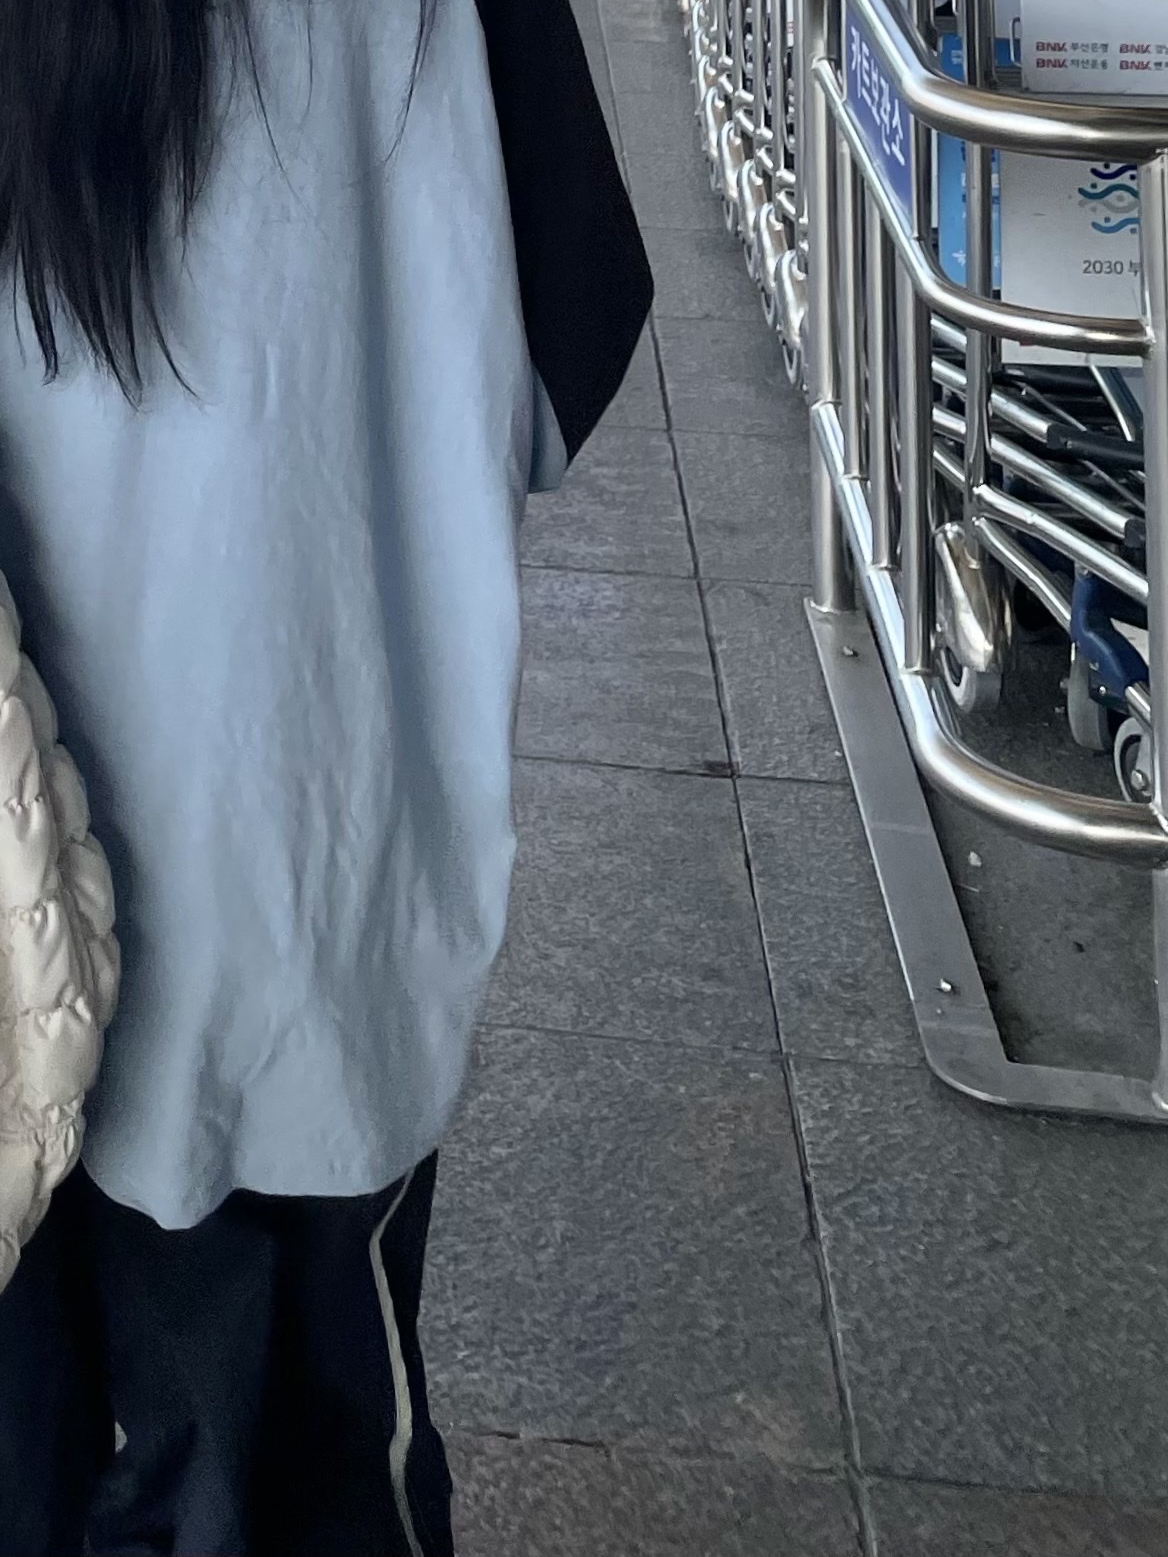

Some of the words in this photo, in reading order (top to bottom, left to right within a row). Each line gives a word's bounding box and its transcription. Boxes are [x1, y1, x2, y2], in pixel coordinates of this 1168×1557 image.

[1035, 41, 1067, 52] BNK
[1119, 43, 1151, 54] BNK
[1035, 58, 1068, 69] BNK
[1119, 60, 1152, 71] BNK
[850, 25, 905, 167] 카트보관소
[1082, 259, 1124, 275] 2030
